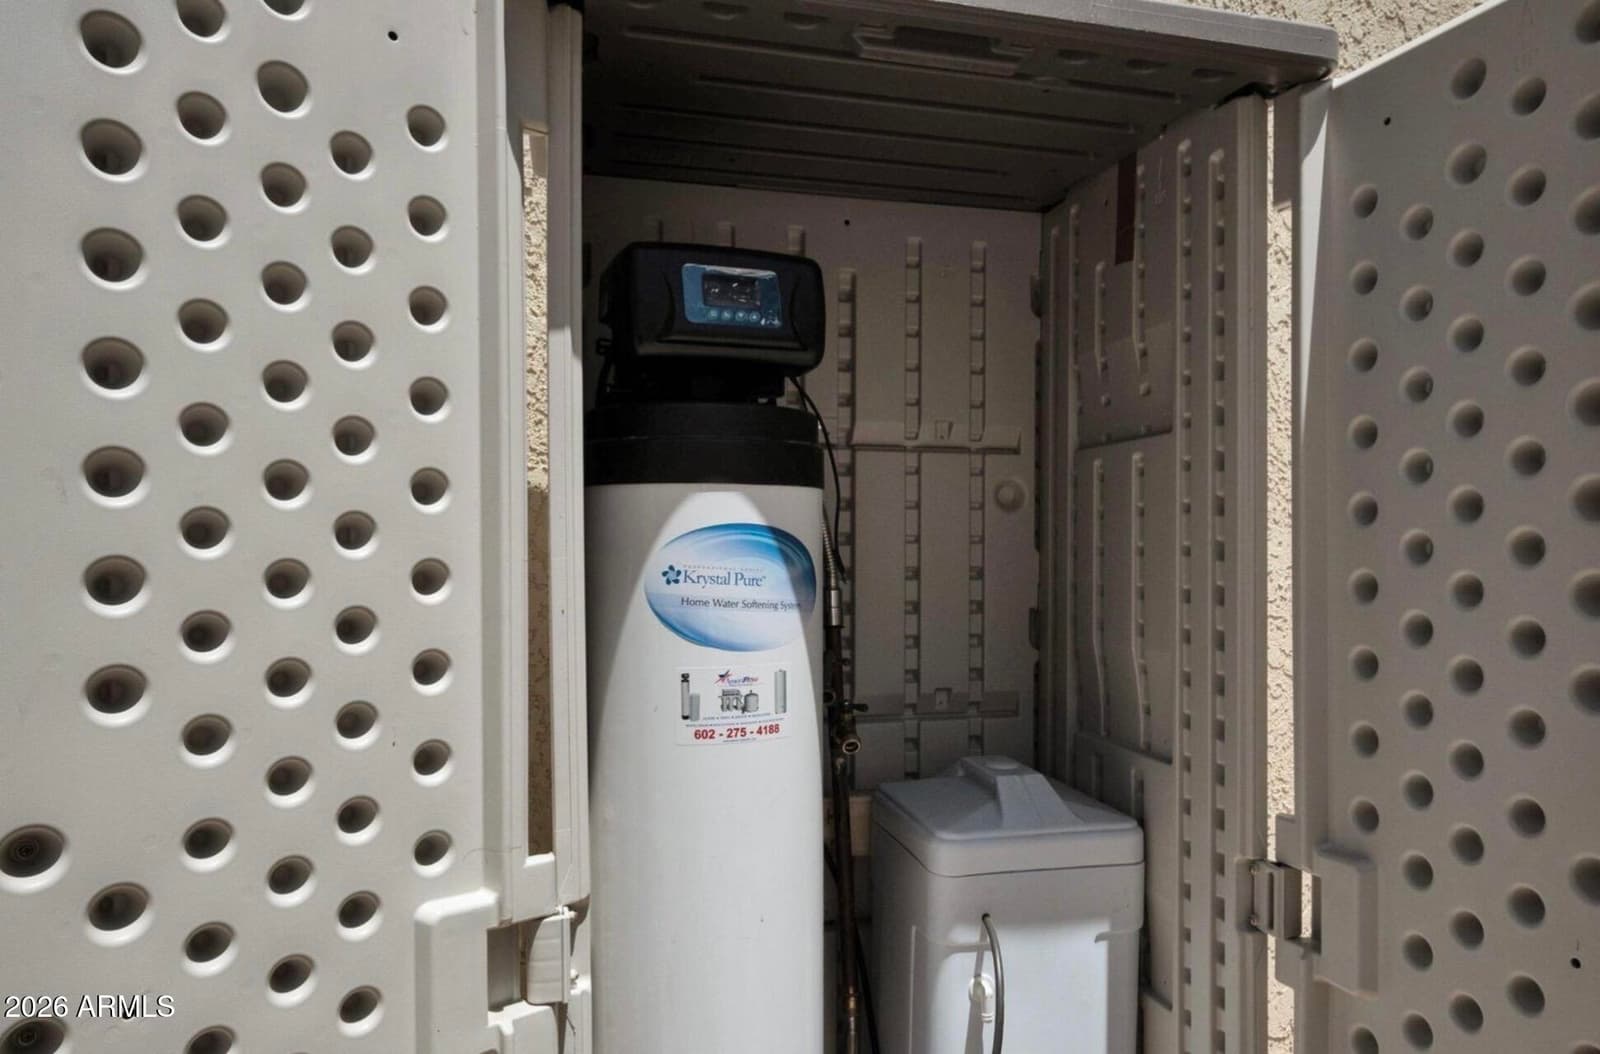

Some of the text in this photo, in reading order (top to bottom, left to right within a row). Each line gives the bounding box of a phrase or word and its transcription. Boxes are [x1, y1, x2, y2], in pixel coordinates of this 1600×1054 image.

[683, 569, 731, 589] Krystal
[680, 597, 711, 607] Home
[712, 598, 739, 608] Water
[741, 599, 778, 611] Softening
[694, 729, 716, 740] 602
[726, 727, 747, 738] 275
